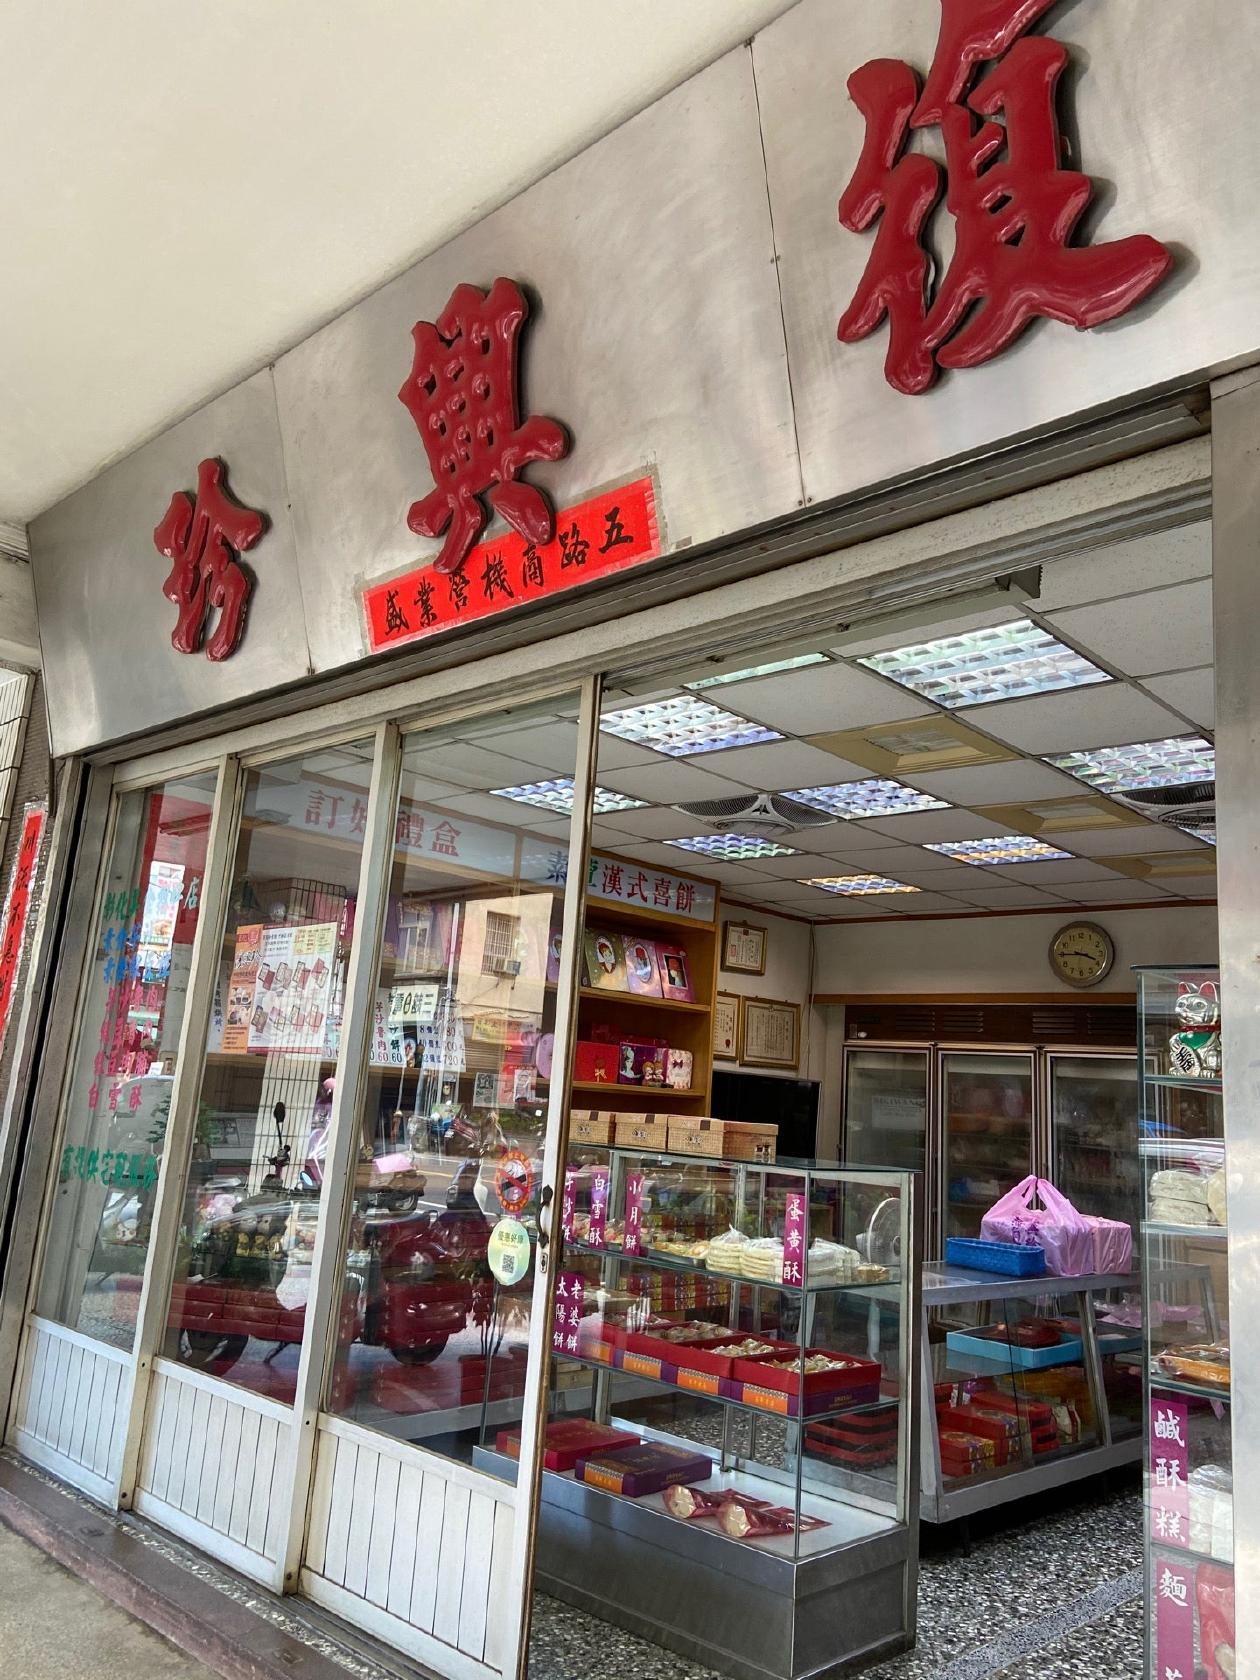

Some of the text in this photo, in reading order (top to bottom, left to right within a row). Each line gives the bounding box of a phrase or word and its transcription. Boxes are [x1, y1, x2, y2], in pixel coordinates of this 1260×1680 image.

[589, 1174, 605, 1246] 白雪酥
[625, 1180, 642, 1250] 小月餅
[783, 1199, 804, 1283] 蛋黃酥
[553, 1276, 569, 1349] 太陽餅
[566, 1278, 582, 1352] 老婆餅
[1153, 1409, 1186, 1542] 鹹酥糕
